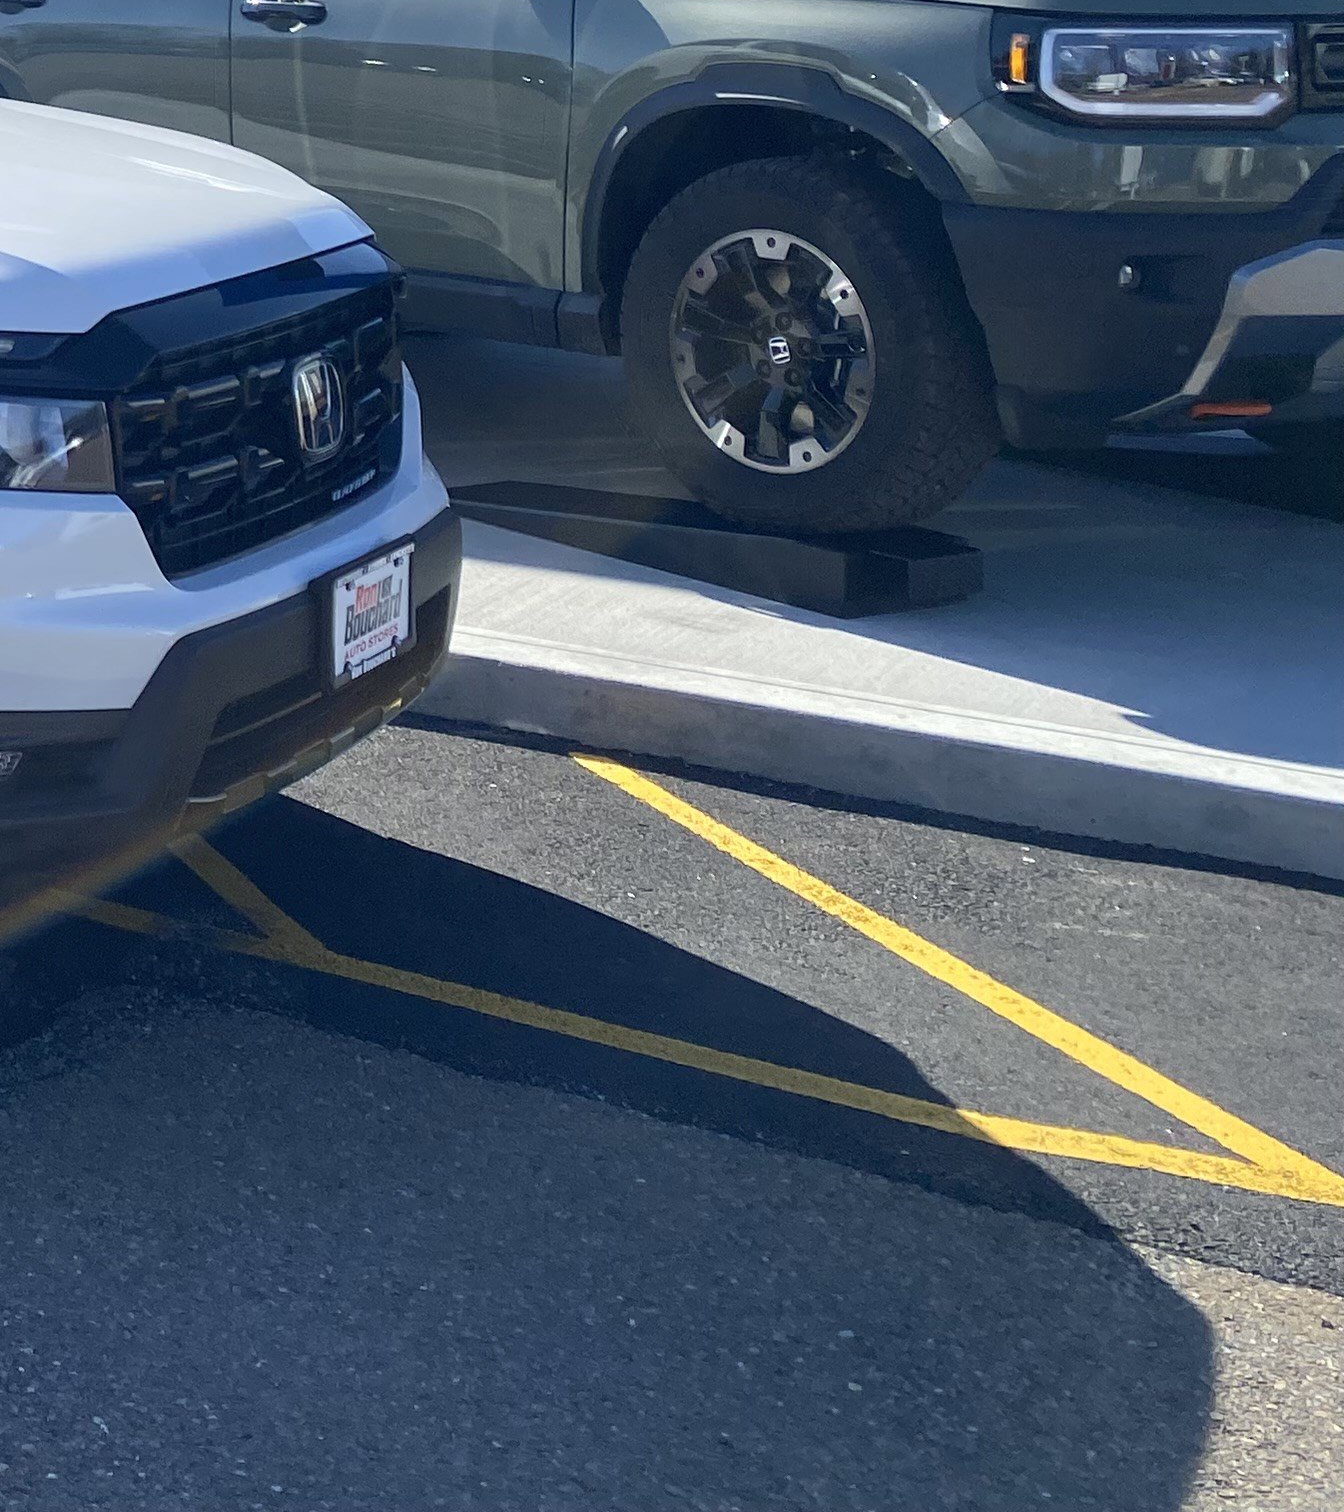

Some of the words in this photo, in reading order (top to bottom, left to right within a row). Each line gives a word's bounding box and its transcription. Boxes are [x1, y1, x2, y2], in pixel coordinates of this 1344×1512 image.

[344, 578, 403, 646] Bouchard
[355, 582, 379, 614] Ron
[344, 639, 367, 662] AUTO
[367, 623, 399, 650] STORES
